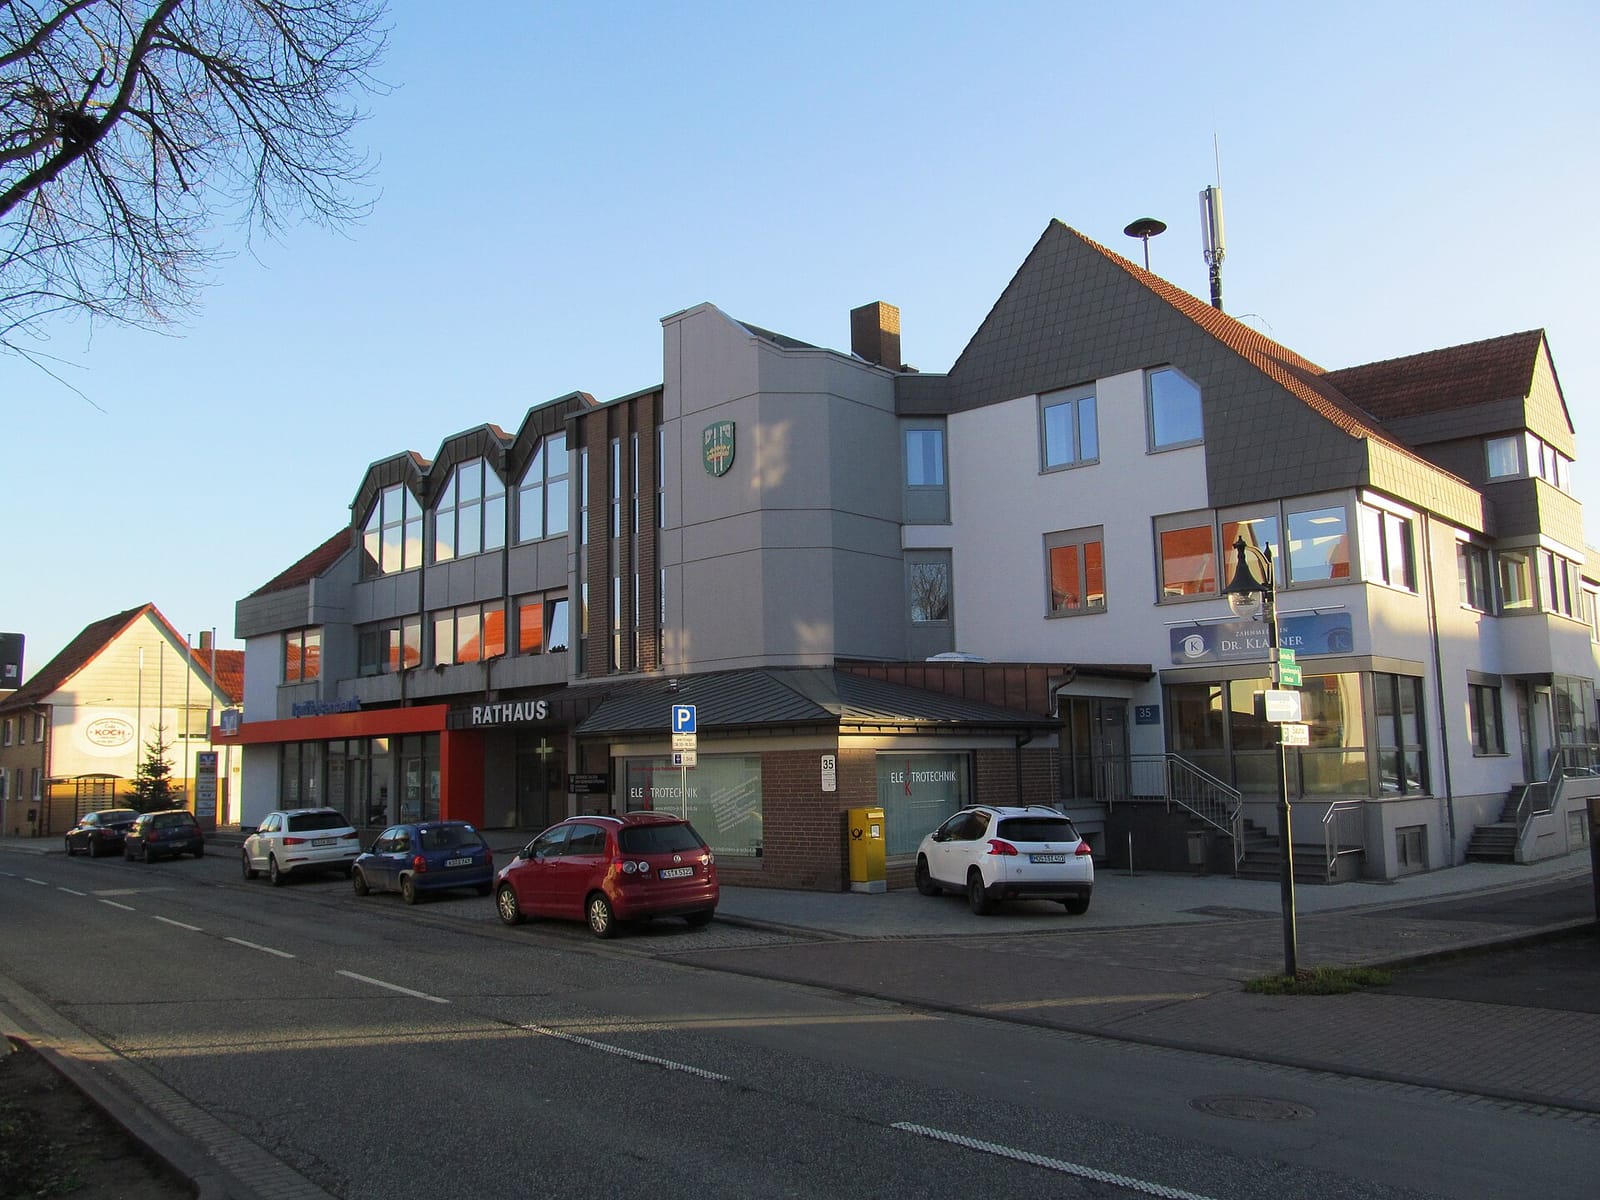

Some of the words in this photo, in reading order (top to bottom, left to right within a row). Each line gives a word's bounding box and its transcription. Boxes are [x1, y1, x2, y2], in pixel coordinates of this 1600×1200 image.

[1221, 640, 1242, 651] DR.
[472, 700, 546, 725] RATHAUS
[1139, 707, 1151, 718] 35
[678, 709, 690, 730] P
[823, 759, 834, 769] 35
[890, 772, 904, 783] ELE
[911, 770, 956, 783] TROTECHNIK
[630, 787, 643, 798] ELE
